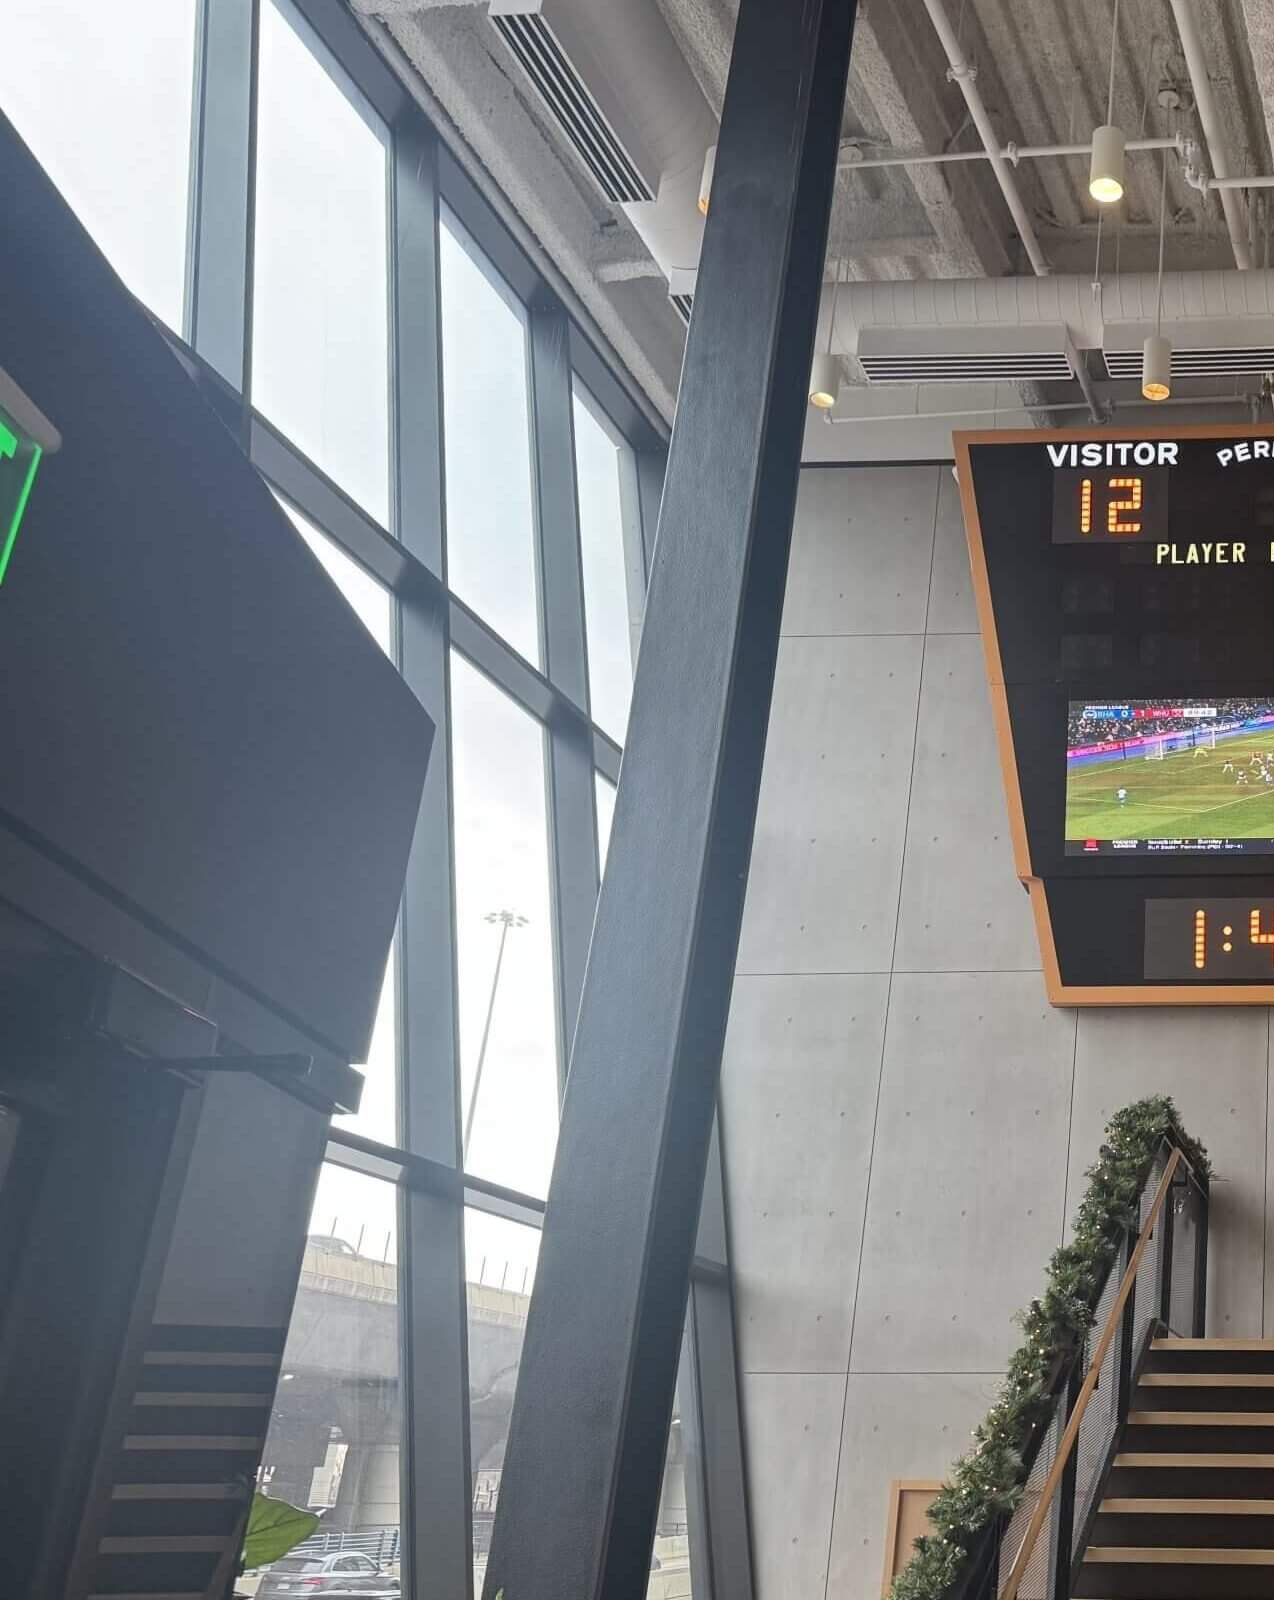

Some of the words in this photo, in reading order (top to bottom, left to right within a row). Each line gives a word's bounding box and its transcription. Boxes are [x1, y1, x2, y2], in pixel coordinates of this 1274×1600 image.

[1047, 441, 1179, 467] VISITOR
[1081, 478, 1142, 533] 12
[1156, 543, 1246, 565] PLAYER
